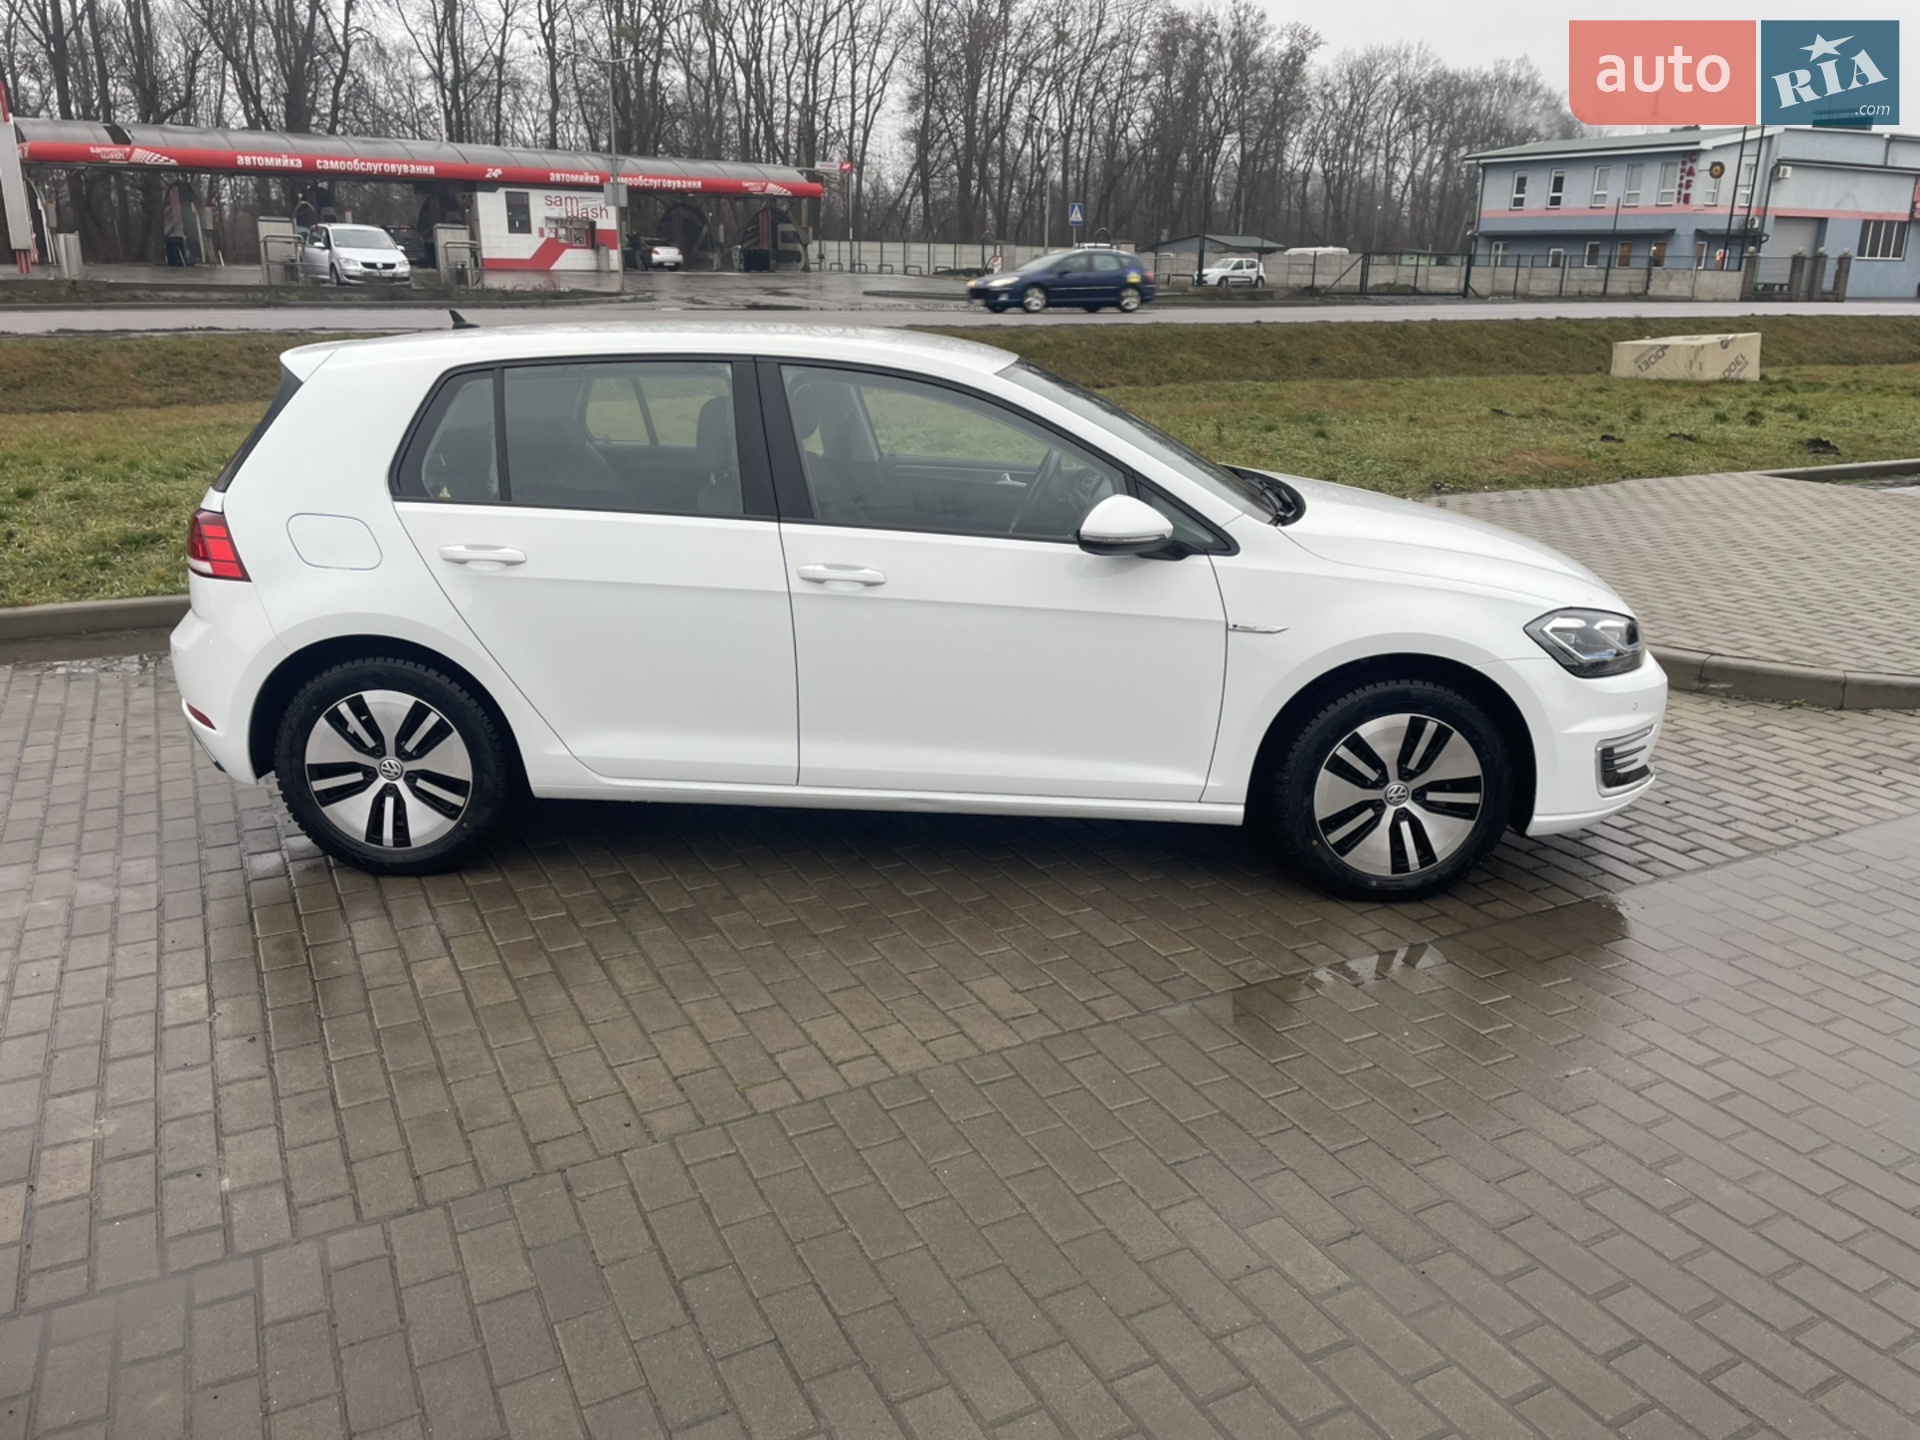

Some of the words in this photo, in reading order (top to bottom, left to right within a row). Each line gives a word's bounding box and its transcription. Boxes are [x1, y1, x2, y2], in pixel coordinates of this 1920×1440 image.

[236, 155, 303, 169] автомийка
[316, 158, 436, 176] самообслуговування
[549, 172, 600, 184] автомийка
[609, 175, 702, 190] мообслуговування
[1682, 151, 1697, 205] CAFE
[1637, 347, 1667, 373] 1300
